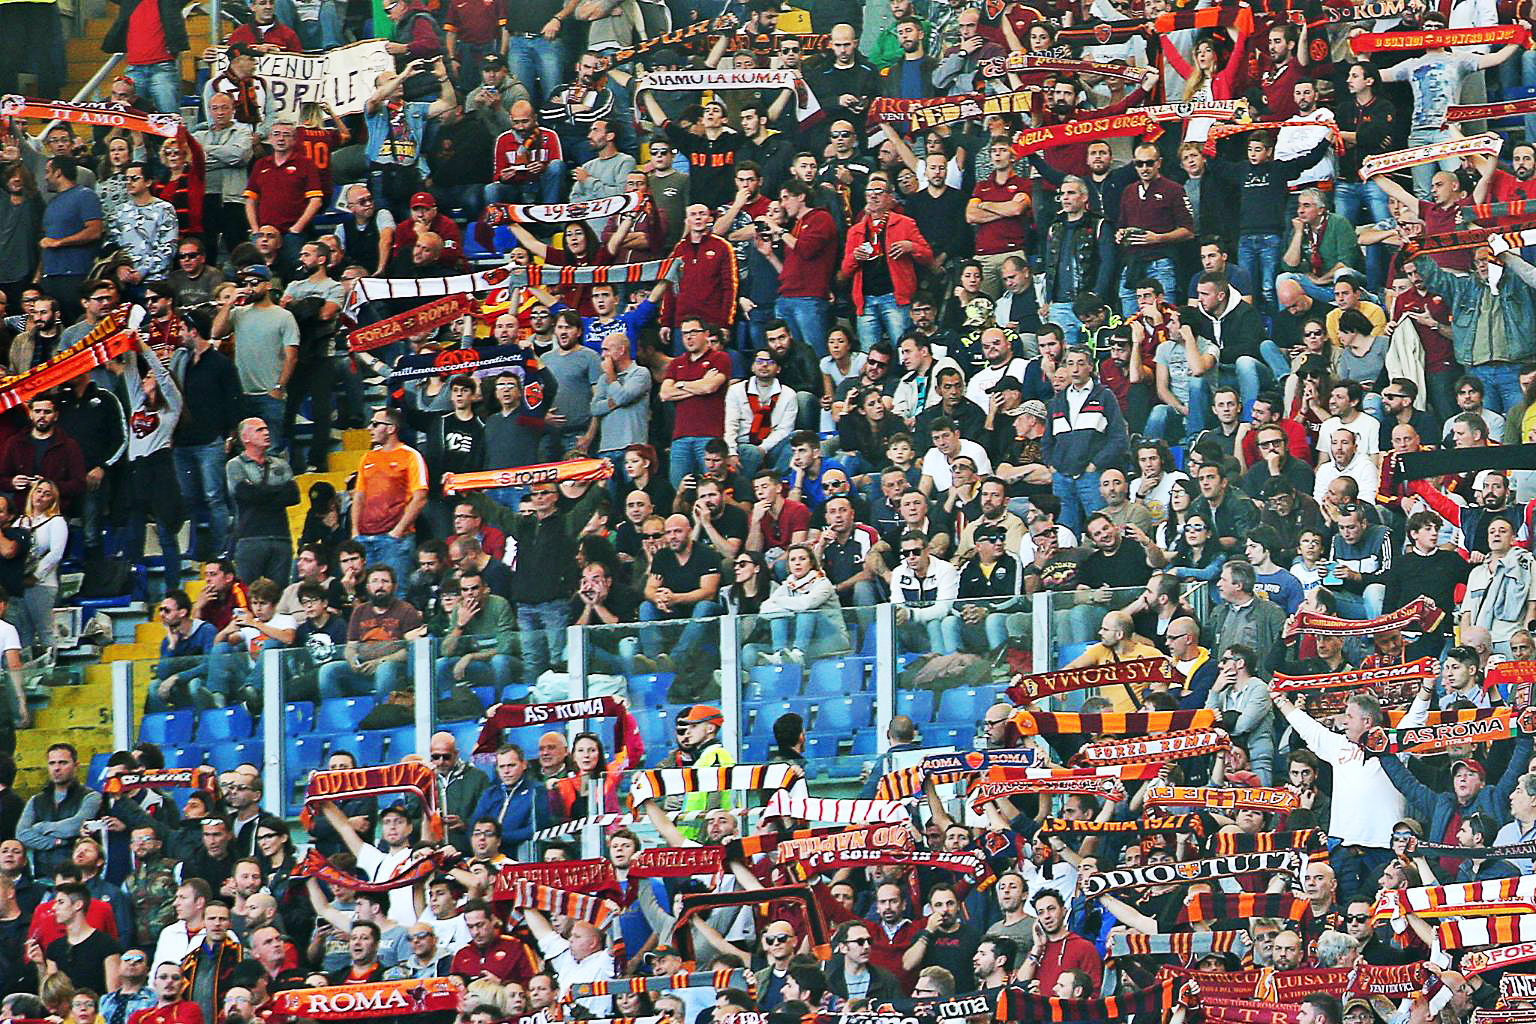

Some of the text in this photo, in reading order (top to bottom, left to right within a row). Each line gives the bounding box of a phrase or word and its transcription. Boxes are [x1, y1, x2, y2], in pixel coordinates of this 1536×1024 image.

[649, 72, 704, 87] SIAMO
[707, 74, 726, 84] LA
[77, 113, 124, 126] AMO
[1065, 121, 1092, 137] SUD
[304, 141, 328, 169] 10
[356, 299, 460, 345] FORZA ROMA
[515, 467, 558, 483] roma
[1363, 664, 1420, 682] ROMA
[1437, 719, 1503, 741] ROMA
[1094, 734, 1210, 759] FORZA ROMA
[989, 752, 1028, 765] ROMA
[1144, 815, 1187, 831] 1927
[1086, 860, 1176, 896] ODIO
[1276, 974, 1320, 989] LUISA
[307, 989, 409, 1013] ROMA
[939, 998, 988, 1018] roma
